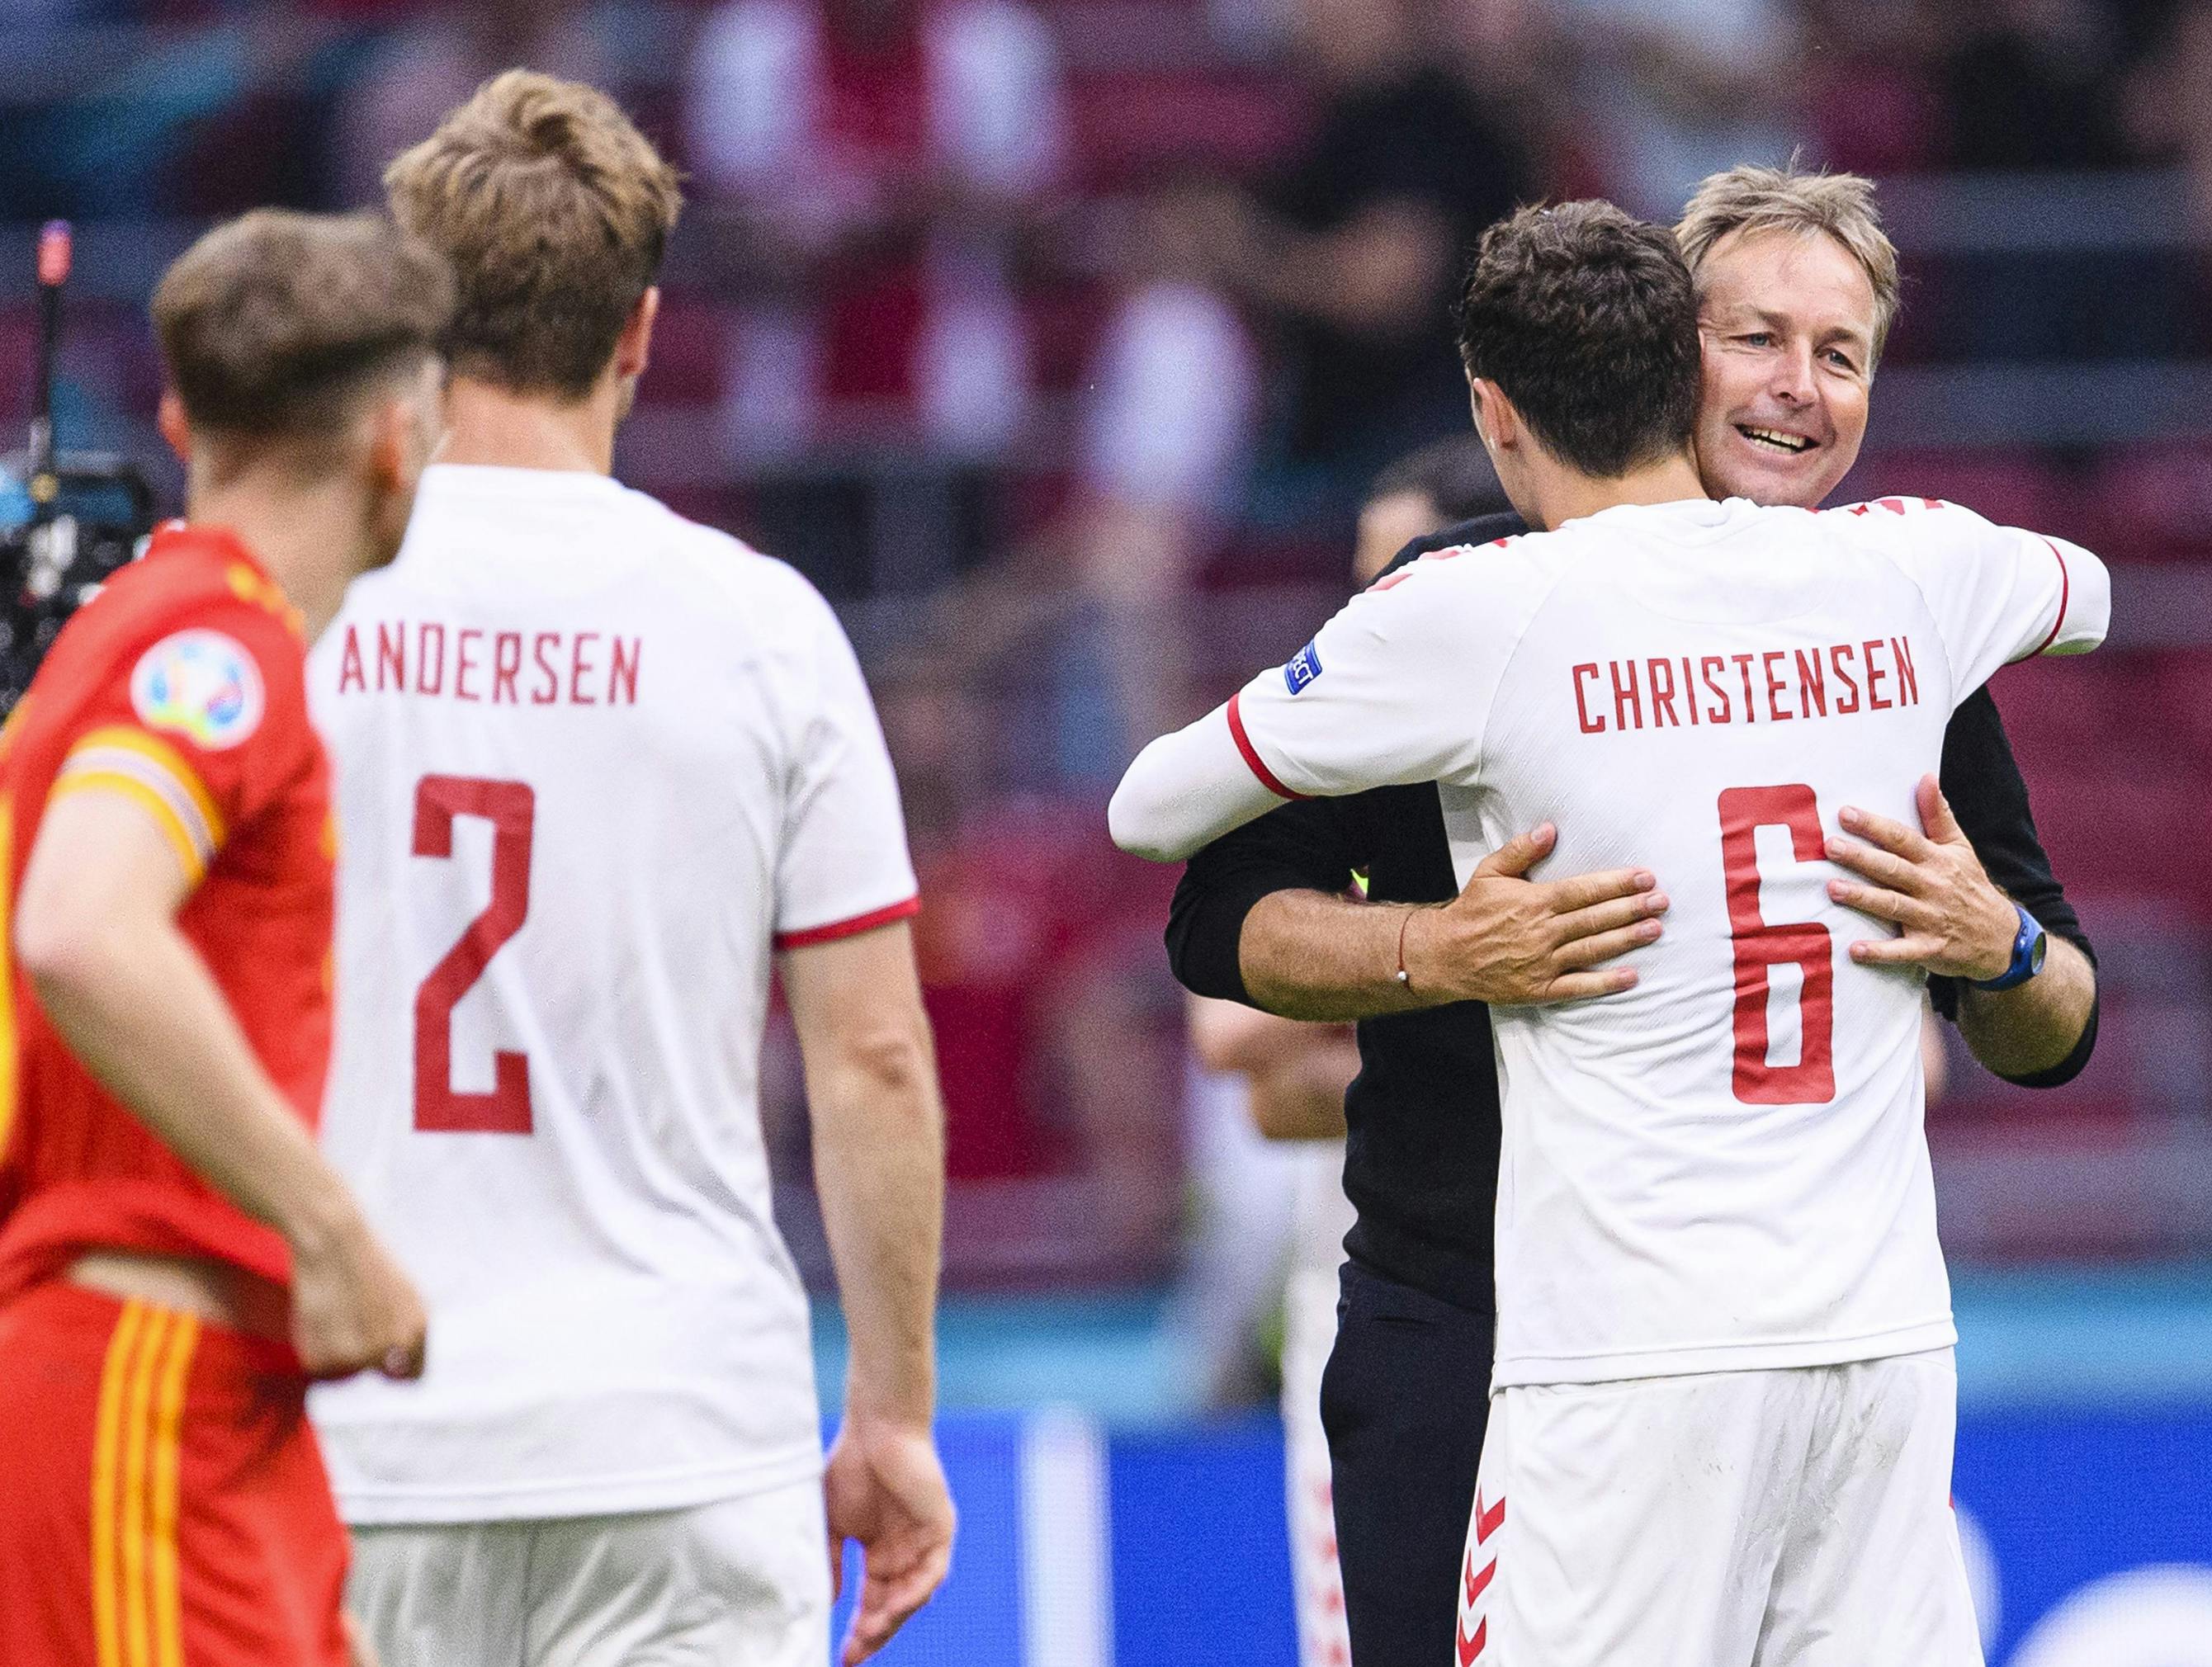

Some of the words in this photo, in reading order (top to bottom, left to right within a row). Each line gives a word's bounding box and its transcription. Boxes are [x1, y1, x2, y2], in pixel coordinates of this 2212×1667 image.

[339, 621, 641, 706] ANDERSEN
[1572, 636, 1918, 733] CHRISTENSEN
[413, 775, 535, 1135] 2
[1718, 783, 1836, 1104] 6
